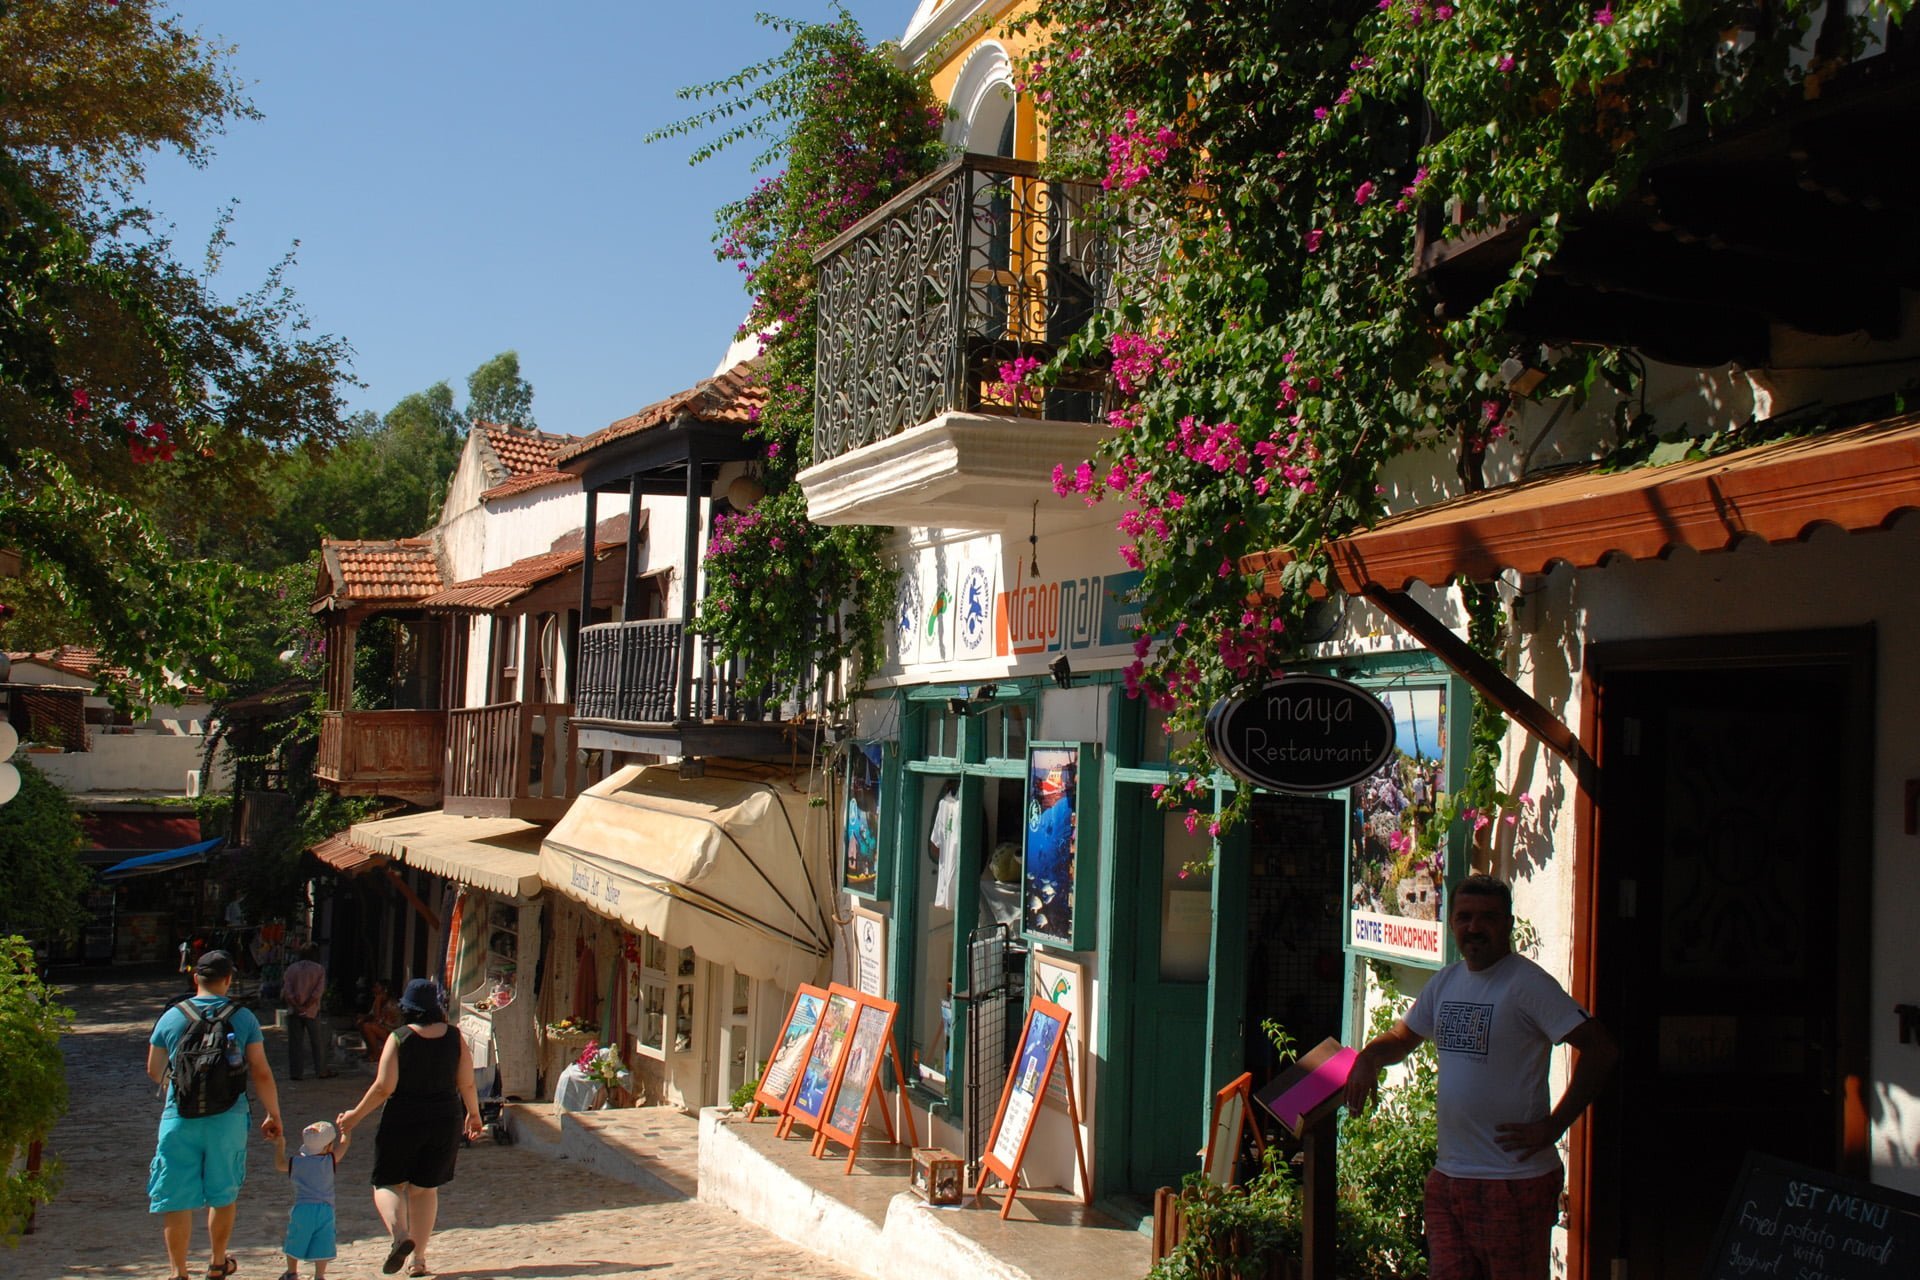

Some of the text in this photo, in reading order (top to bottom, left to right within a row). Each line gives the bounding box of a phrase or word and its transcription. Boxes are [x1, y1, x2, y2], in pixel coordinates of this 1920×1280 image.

[1011, 555, 1101, 655] dragoman
[1266, 695, 1353, 736] maya
[1244, 727, 1374, 766] Restaurant
[1355, 918, 1438, 953] CENTRE FRANCOPHONE
[1738, 1199, 1782, 1237] Fried
[1780, 1217, 1835, 1250] potato
[1785, 1179, 1889, 1230] SET MENU
[1792, 1244, 1825, 1270] with
